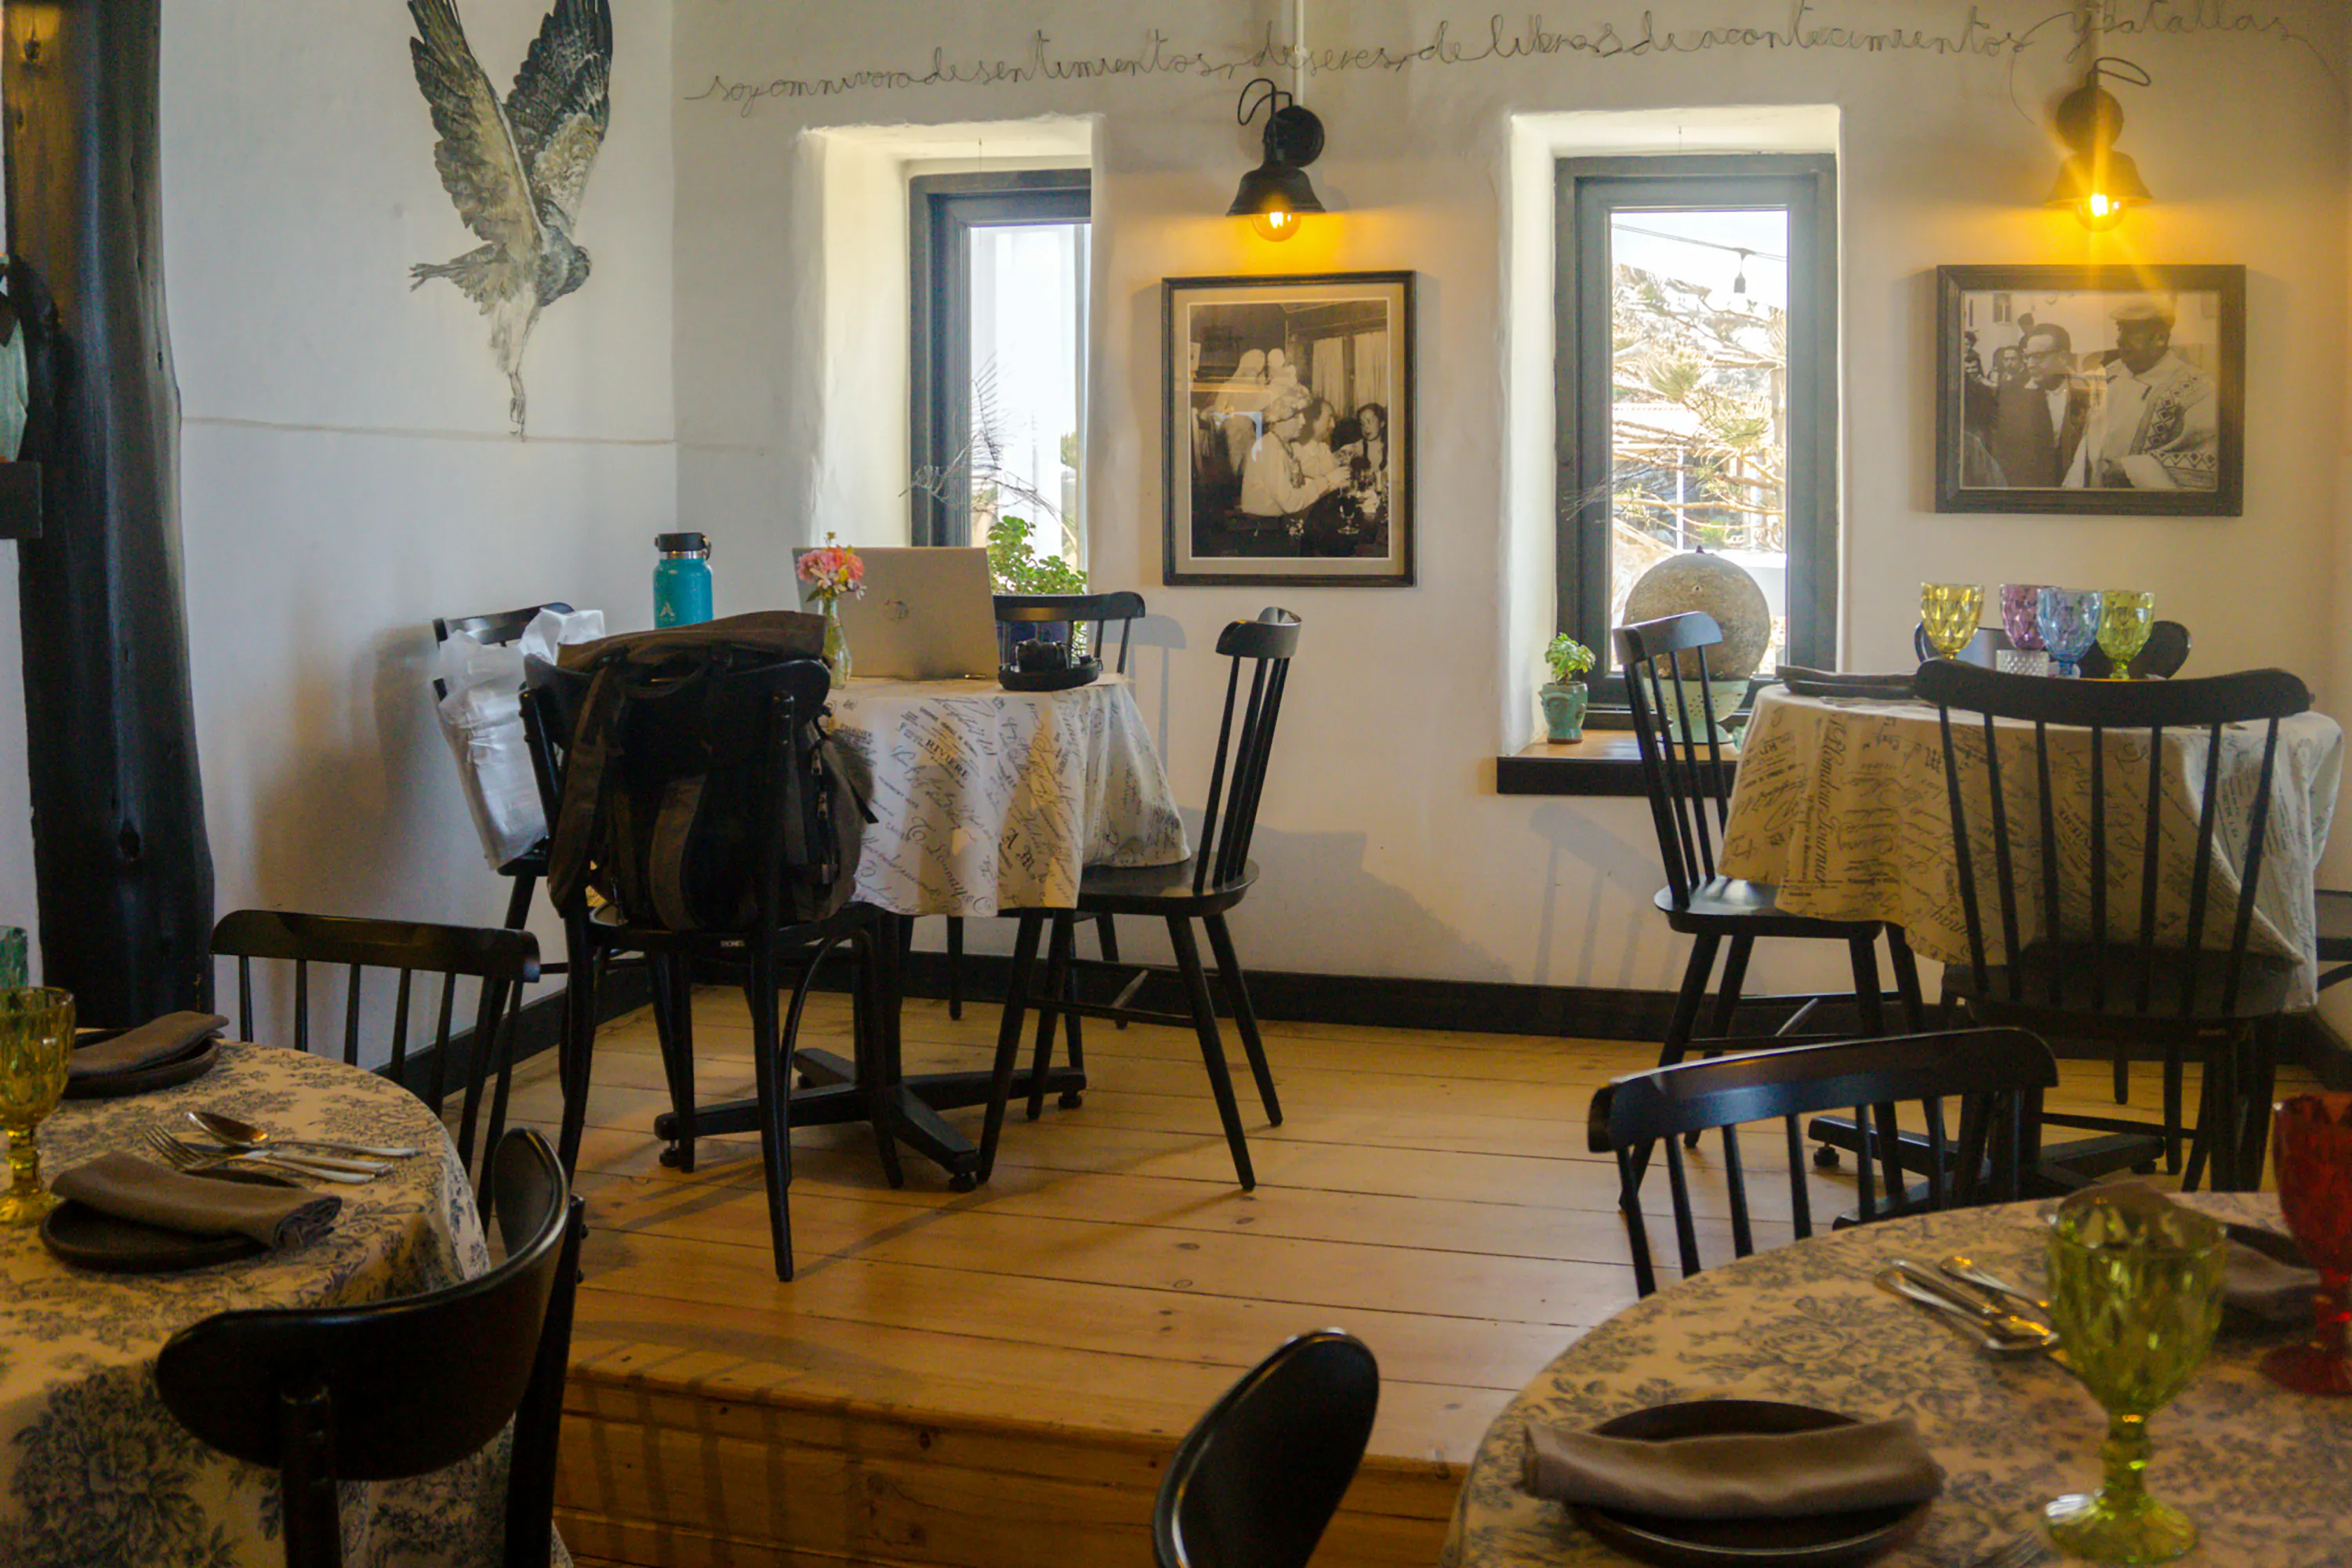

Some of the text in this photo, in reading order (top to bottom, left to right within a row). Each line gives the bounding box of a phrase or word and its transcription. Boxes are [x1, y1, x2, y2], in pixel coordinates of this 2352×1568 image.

[687, 75, 760, 118] soy
[922, 31, 960, 85] de
[1252, 20, 1295, 71] de
[1417, 20, 1462, 64] de
[1629, 9, 1676, 56] de
